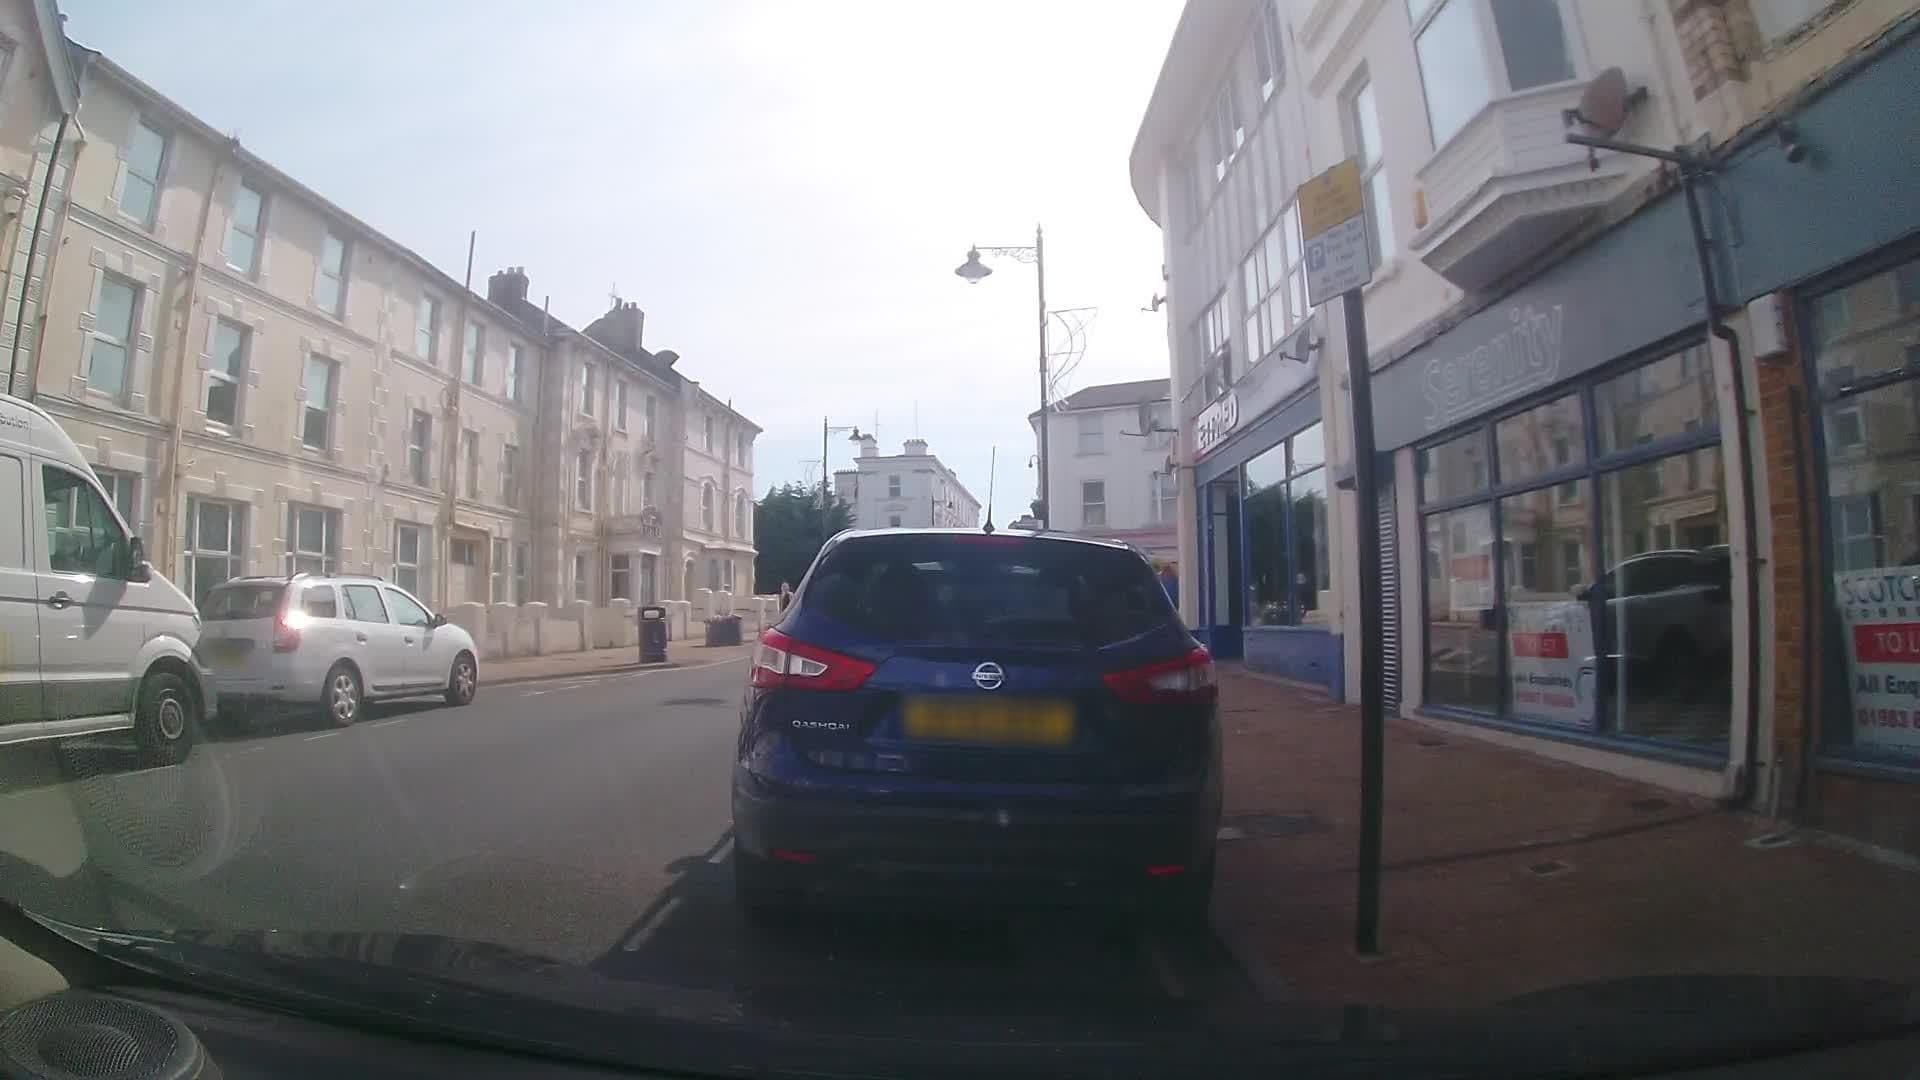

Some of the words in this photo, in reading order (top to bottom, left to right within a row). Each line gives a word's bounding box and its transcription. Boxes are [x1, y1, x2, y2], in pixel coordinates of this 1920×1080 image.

[1424, 304, 1563, 430] Serenity
[1873, 631, 1902, 654] TO
[1856, 673, 1880, 693] All
[792, 719, 850, 730] QASHQAI
